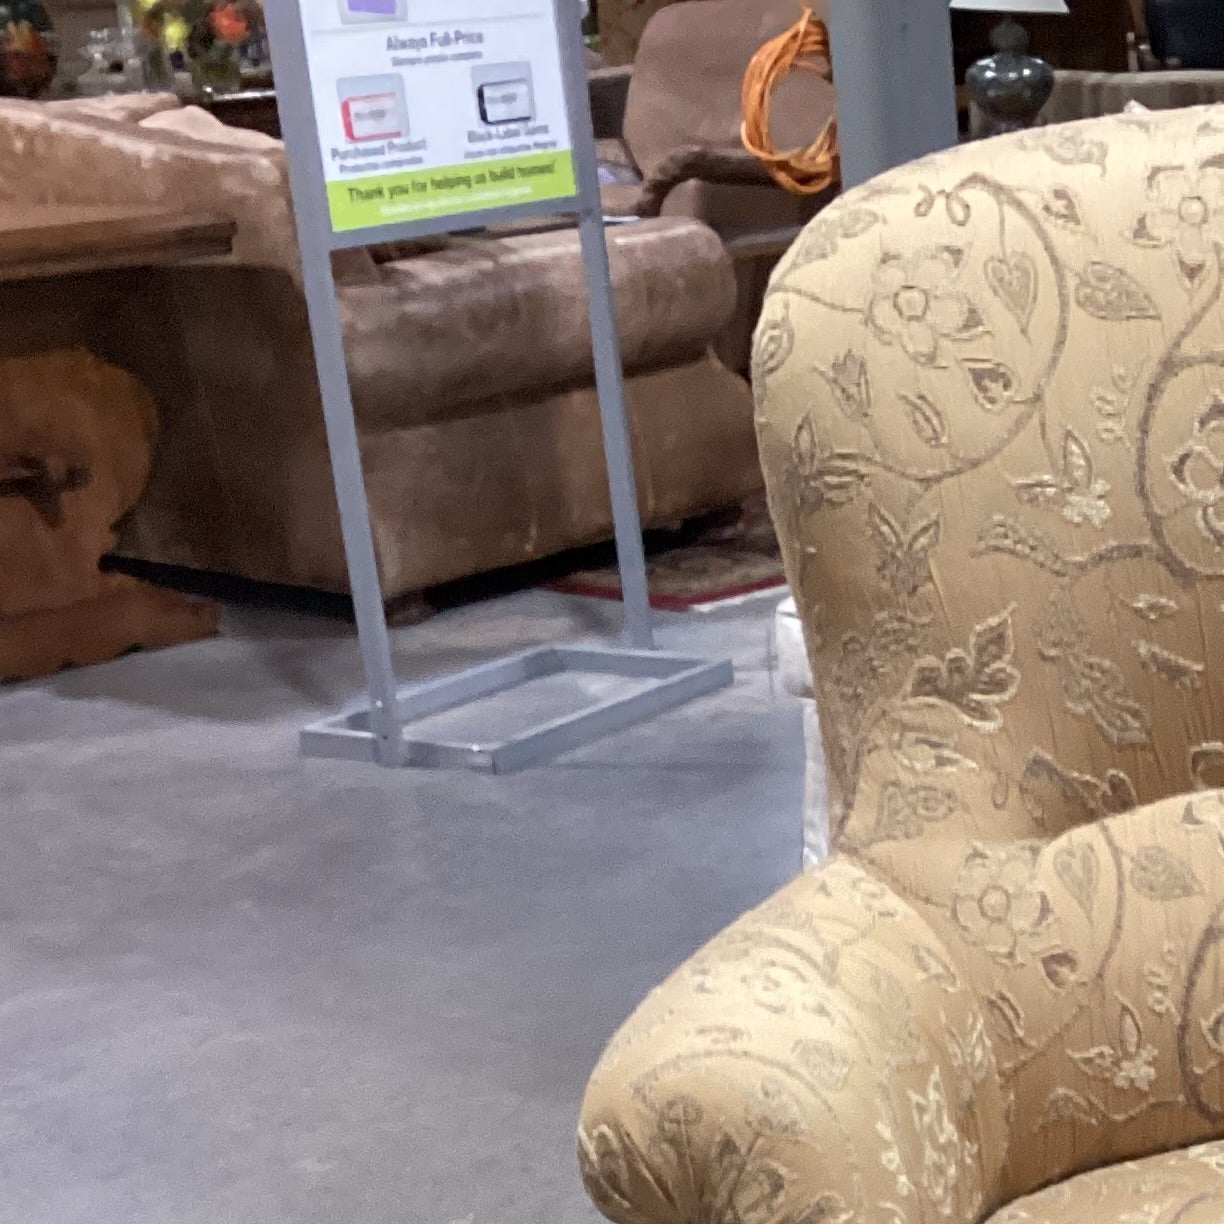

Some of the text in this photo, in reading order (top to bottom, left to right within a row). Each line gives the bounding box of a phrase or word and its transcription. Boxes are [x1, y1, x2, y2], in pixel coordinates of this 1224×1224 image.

[347, 184, 385, 203] Thank
[386, 183, 409, 201] you
[410, 178, 428, 194] for
[429, 174, 472, 193] helping
[488, 166, 516, 183] build
